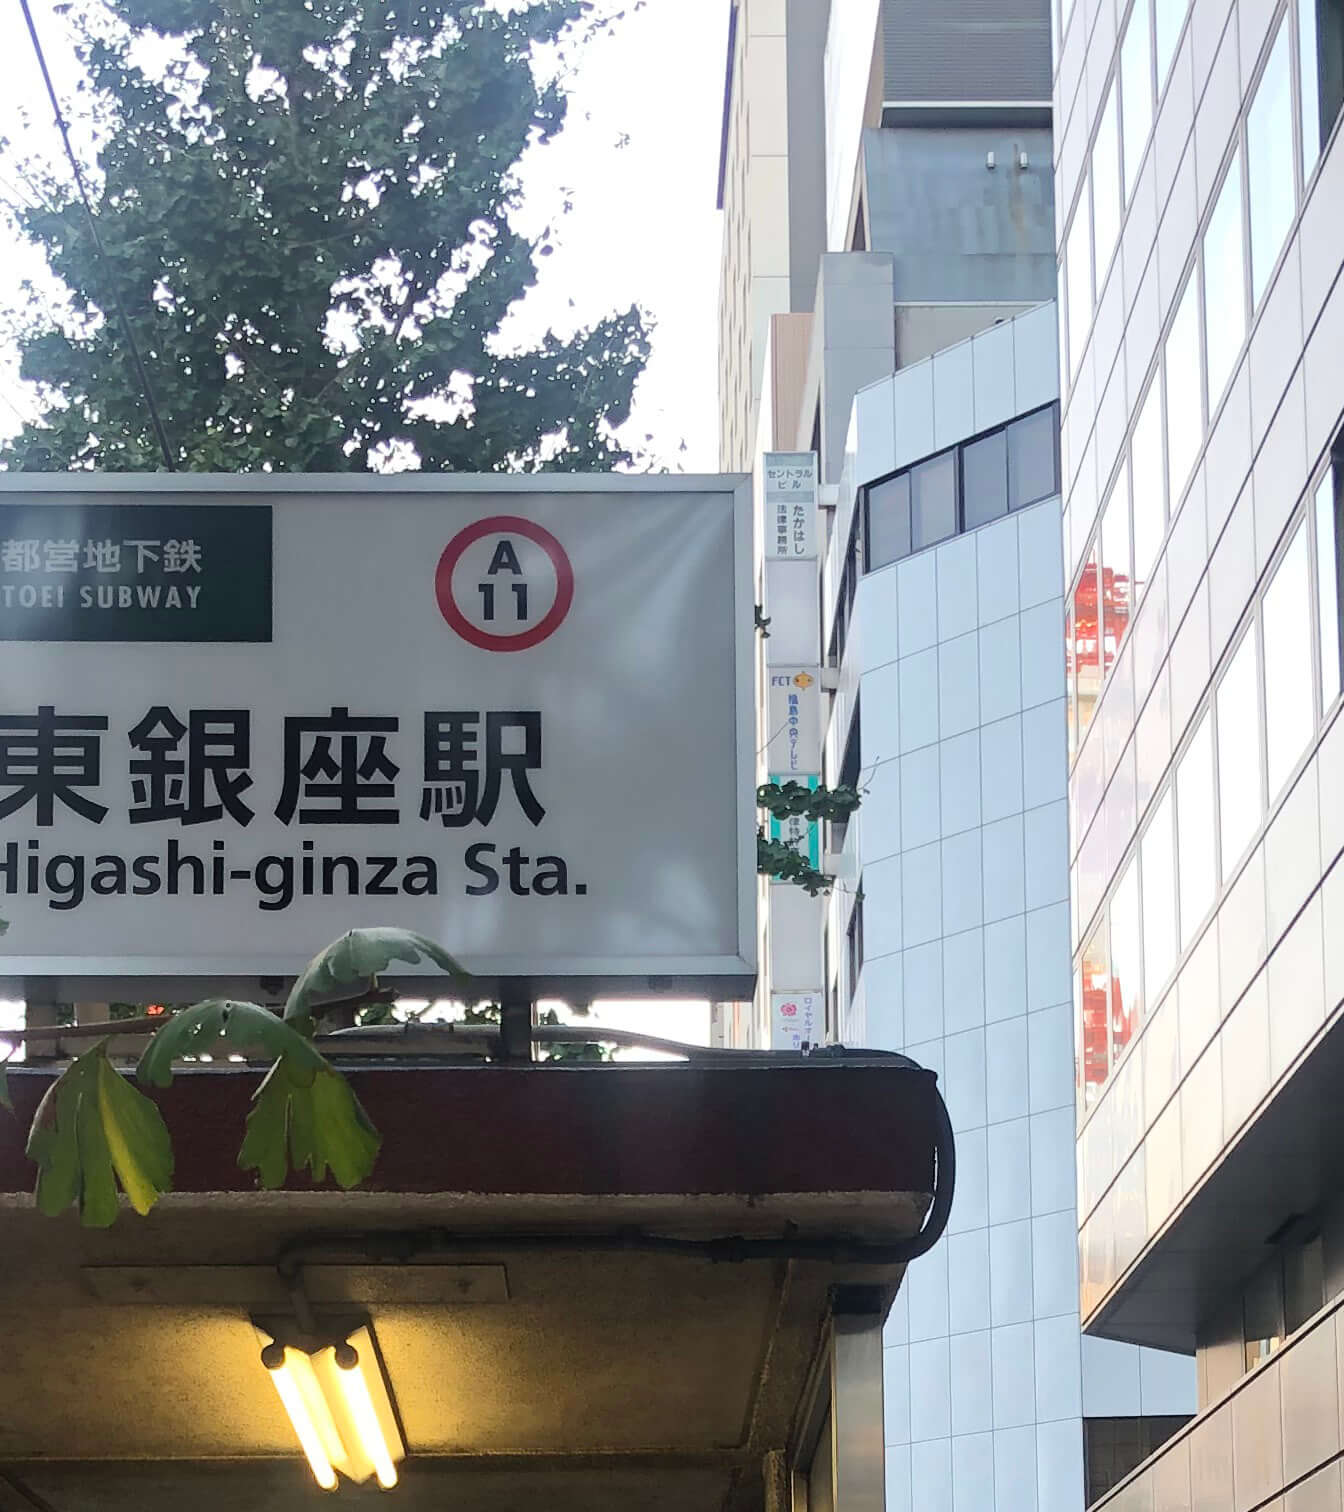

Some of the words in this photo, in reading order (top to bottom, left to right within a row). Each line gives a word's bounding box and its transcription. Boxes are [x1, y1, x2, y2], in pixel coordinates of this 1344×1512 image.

[768, 469, 813, 479] セントラル
[778, 480, 802, 489] ビル
[792, 504, 805, 554] たかはし
[0, 538, 203, 575] 都営地下鉄
[487, 539, 523, 576] A
[1, 584, 65, 609] TOEI
[79, 585, 202, 610] SUBWAY
[478, 583, 528, 621] 11
[771, 676, 792, 687] FCT
[464, 842, 588, 898] Sta.
